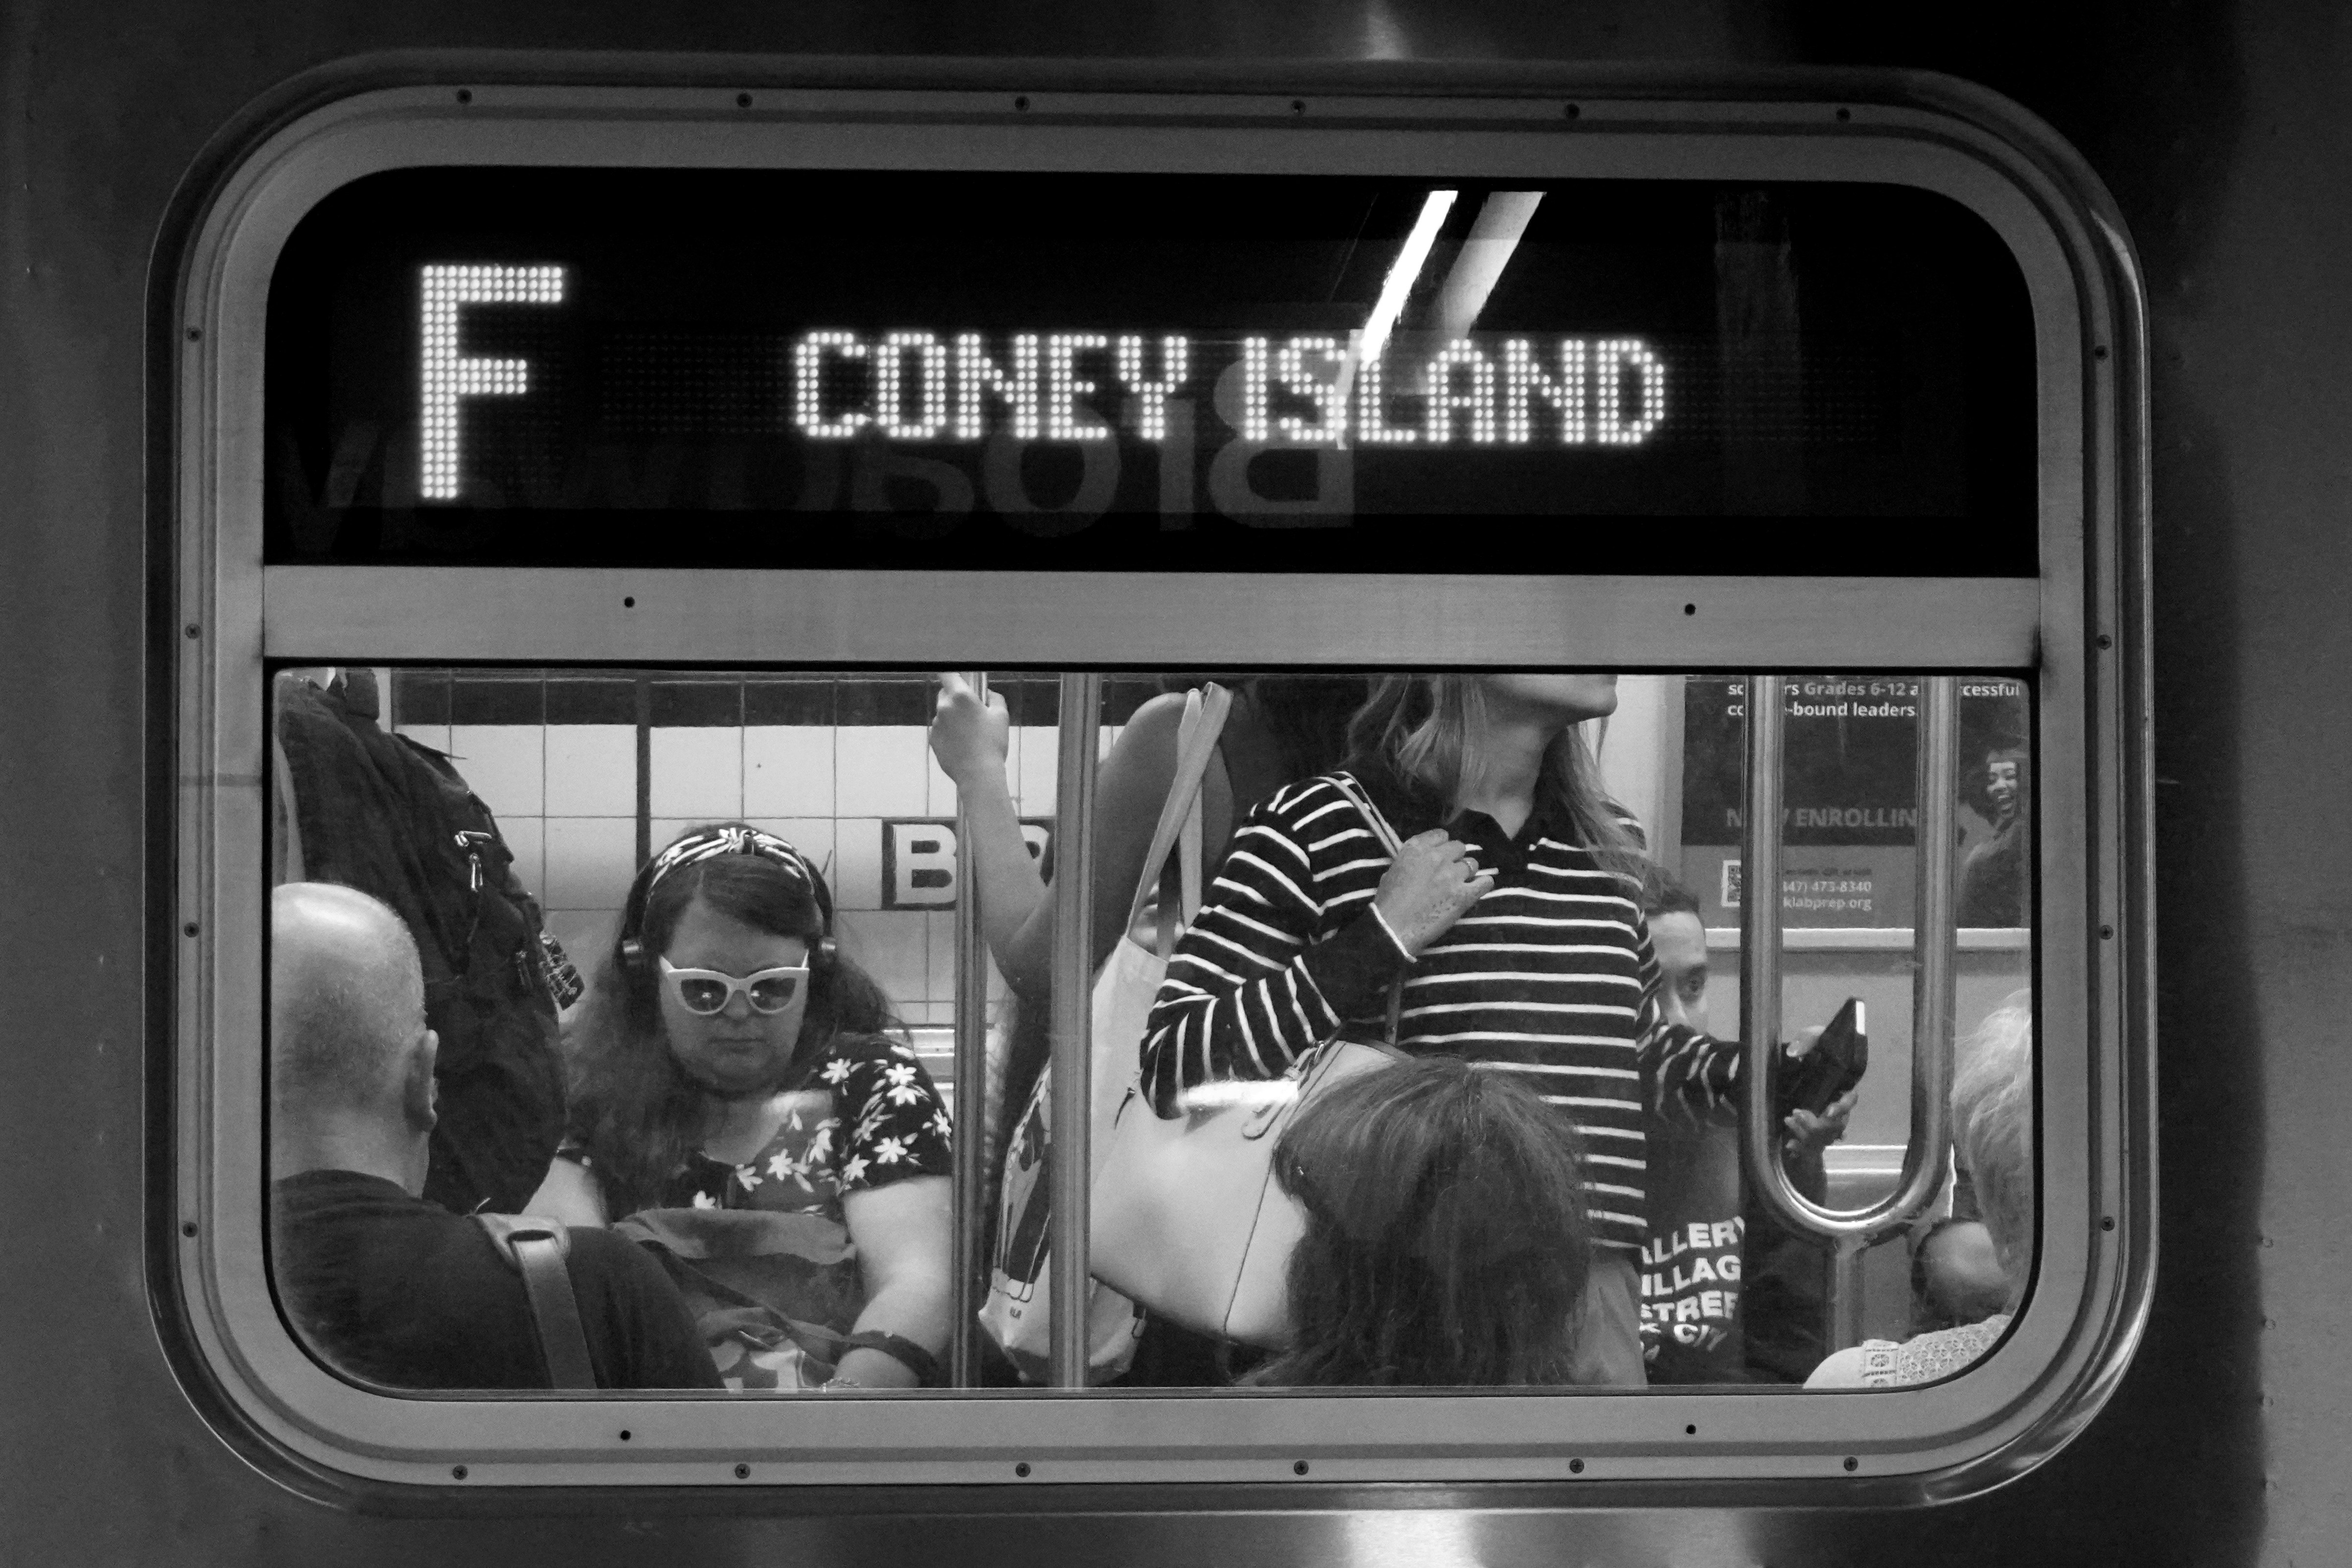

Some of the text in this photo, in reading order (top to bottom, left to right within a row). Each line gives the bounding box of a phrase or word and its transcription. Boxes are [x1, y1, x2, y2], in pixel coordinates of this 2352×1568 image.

[422, 264, 564, 499] F
[796, 331, 1666, 444] CONEY ISLAND
[1804, 681, 1866, 696] Grades
[1870, 682, 1905, 696] 6-12
[1963, 682, 2020, 696] cessful
[1796, 808, 1918, 827] ENROLLIN
[1642, 1255, 1741, 1296] ILLAG
